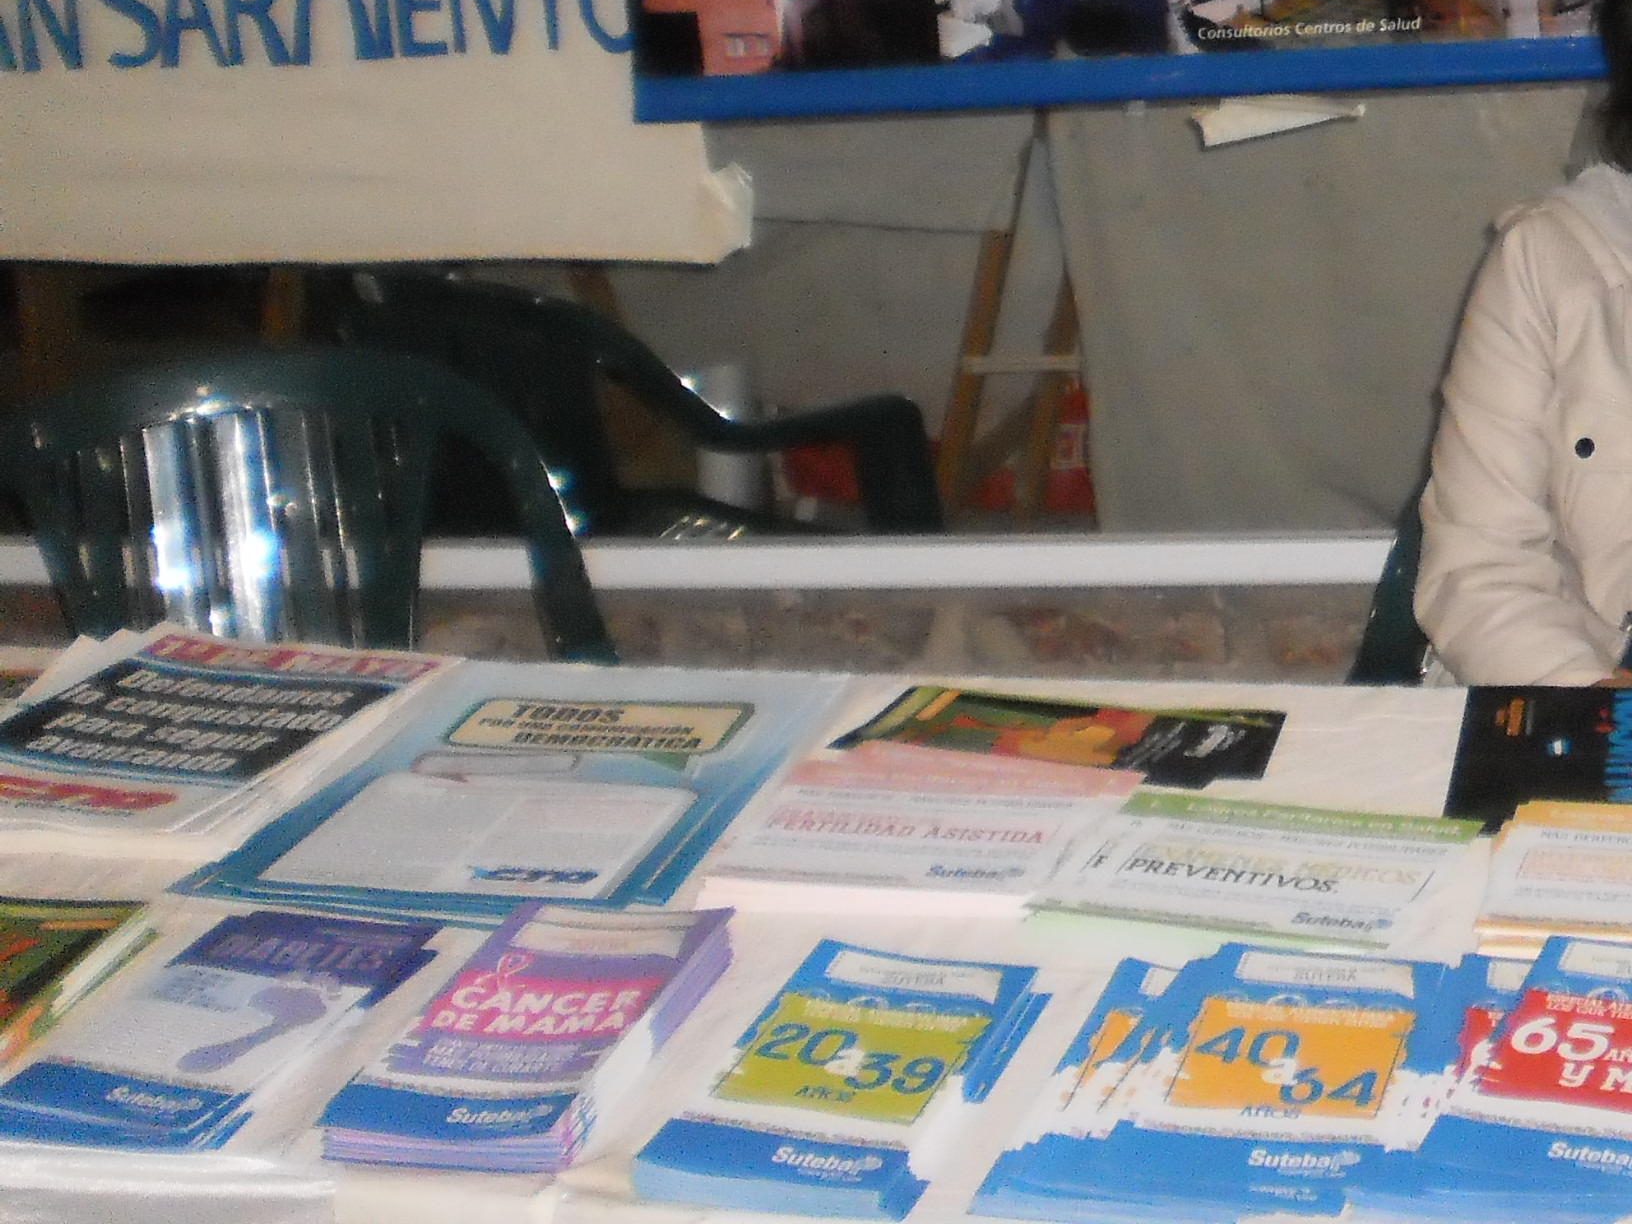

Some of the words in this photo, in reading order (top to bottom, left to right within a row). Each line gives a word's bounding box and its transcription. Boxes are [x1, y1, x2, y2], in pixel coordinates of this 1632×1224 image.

[1197, 22, 1291, 41] Consultorios
[1294, 19, 1354, 37] Centros
[1357, 19, 1376, 34] de
[1379, 16, 1423, 33] Salud
[920, 824, 1045, 845] ASISTIDA
[1292, 910, 1368, 932] Suteba
[431, 1009, 479, 1031] DE
[1510, 1016, 1616, 1063] 65
[754, 1022, 859, 1067] 20
[842, 1051, 946, 1095] 39
[1194, 1025, 1300, 1068] 40
[1277, 1066, 1380, 1109] 64
[771, 1145, 861, 1175] Suteba
[1247, 1147, 1333, 1170] Suteba
[1546, 1140, 1632, 1169] Suteba
